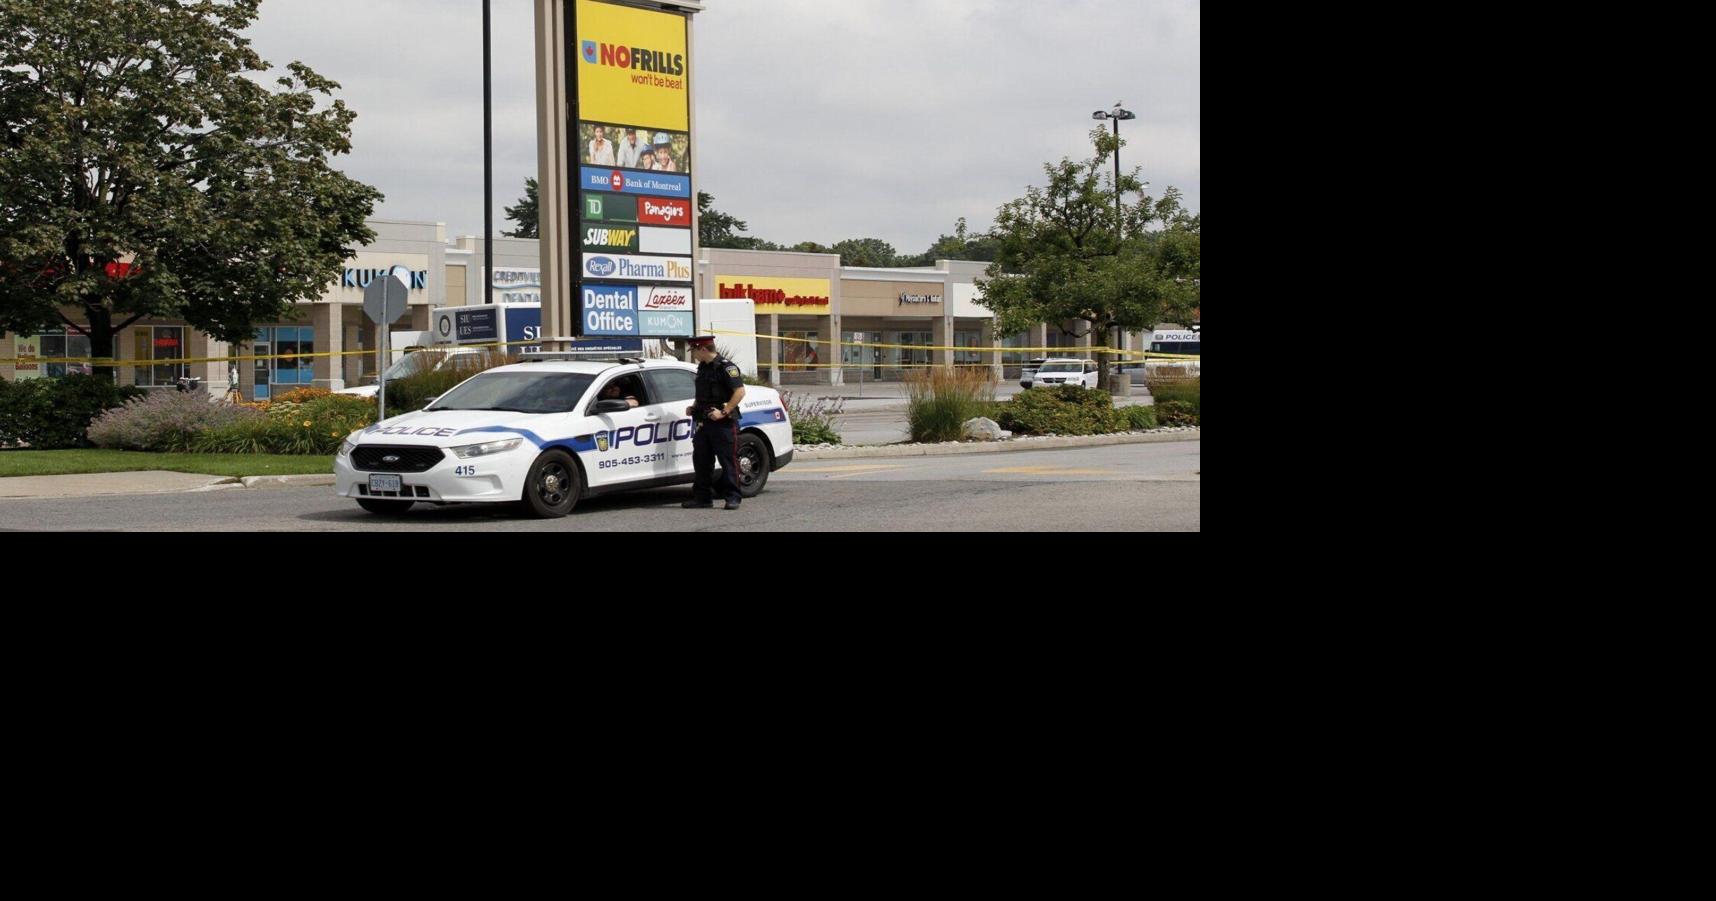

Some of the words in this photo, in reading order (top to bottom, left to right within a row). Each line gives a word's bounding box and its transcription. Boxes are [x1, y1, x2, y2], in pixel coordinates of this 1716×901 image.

[631, 74, 653, 86] won't
[654, 76, 664, 87] be
[591, 175, 609, 185] BMO
[625, 178, 643, 188] Bank
[643, 180, 651, 189] of
[651, 181, 681, 192] Montreal
[587, 199, 602, 214] TD
[583, 228, 636, 247] SUBWAY
[589, 260, 613, 275] Rexall
[619, 258, 664, 277] Pharma
[667, 260, 690, 278] Plus
[584, 289, 633, 310] Dental
[587, 310, 633, 331] Office
[647, 314, 684, 329] KUMON
[598, 452, 665, 469] 905-453-3311
[455, 465, 475, 476] 415
